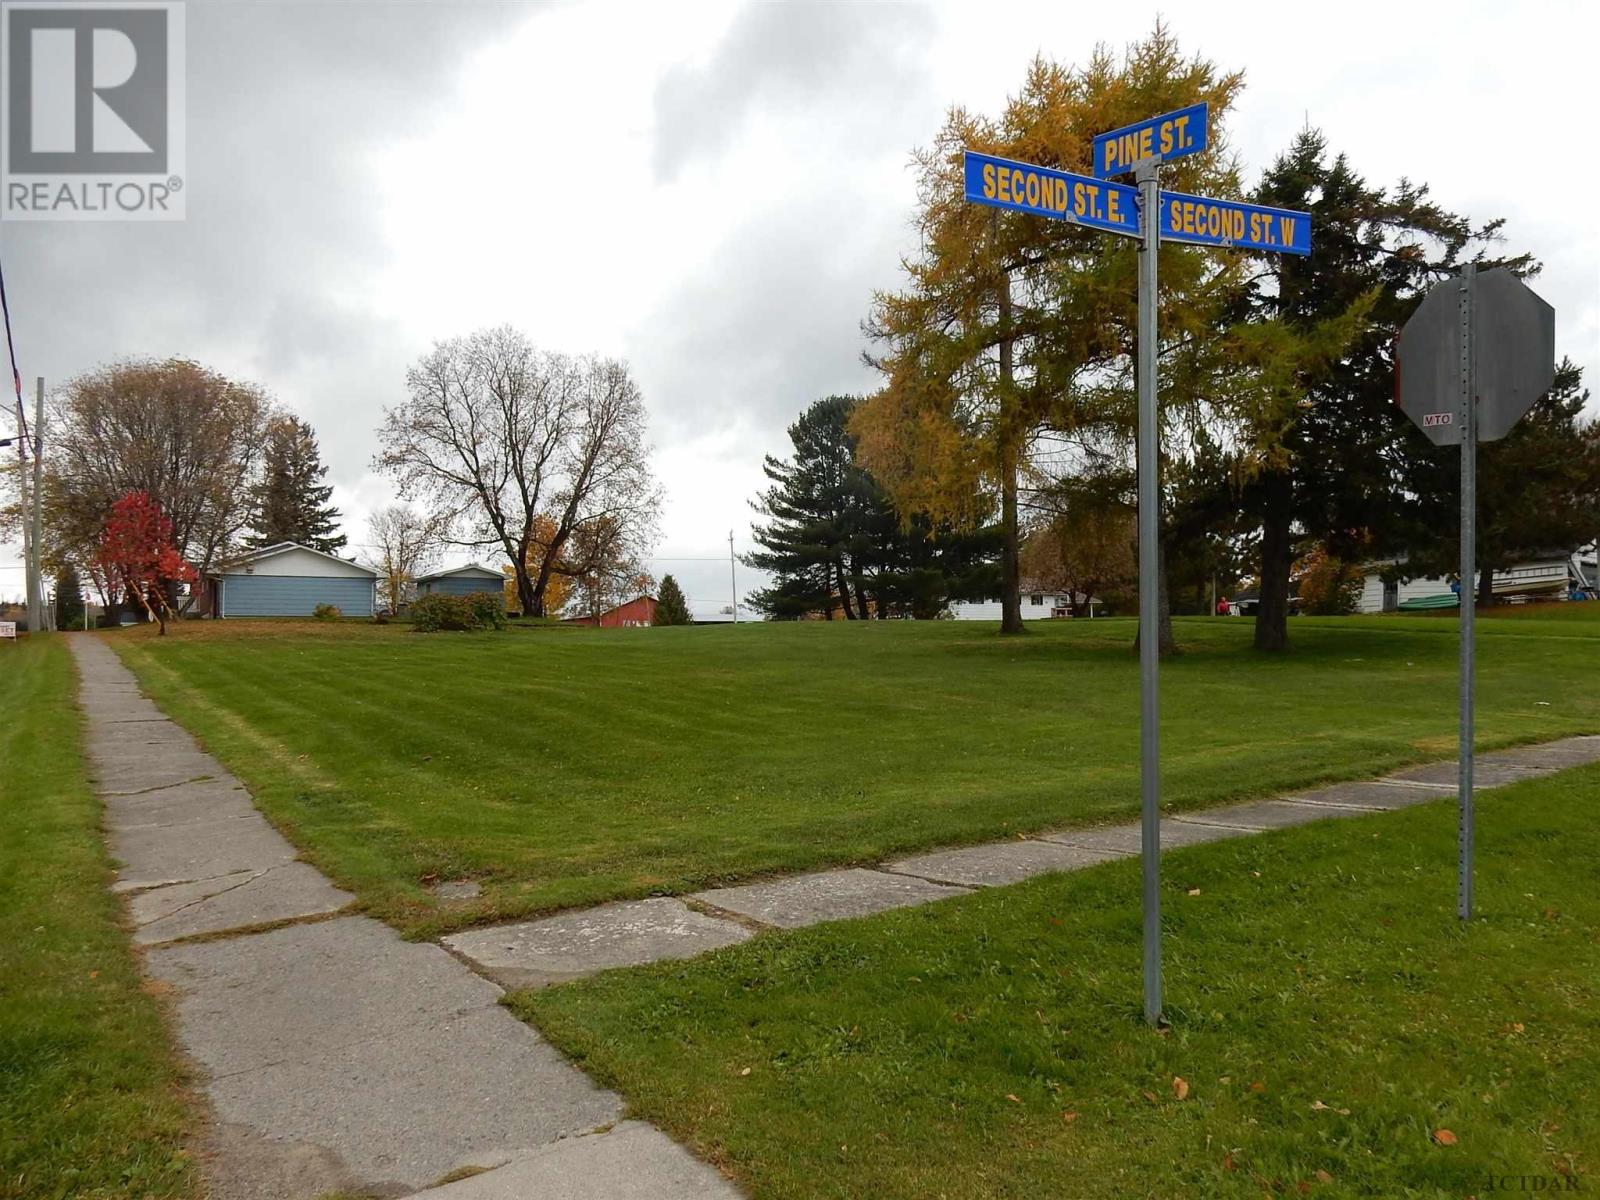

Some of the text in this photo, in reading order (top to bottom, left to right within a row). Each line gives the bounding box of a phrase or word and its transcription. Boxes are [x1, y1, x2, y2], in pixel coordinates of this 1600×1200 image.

[1104, 115, 1193, 171] PINE ST.
[982, 163, 1125, 224] SECOND ST. E.
[1170, 200, 1295, 247] SECOND ST. W
[1424, 414, 1450, 425] MTO
